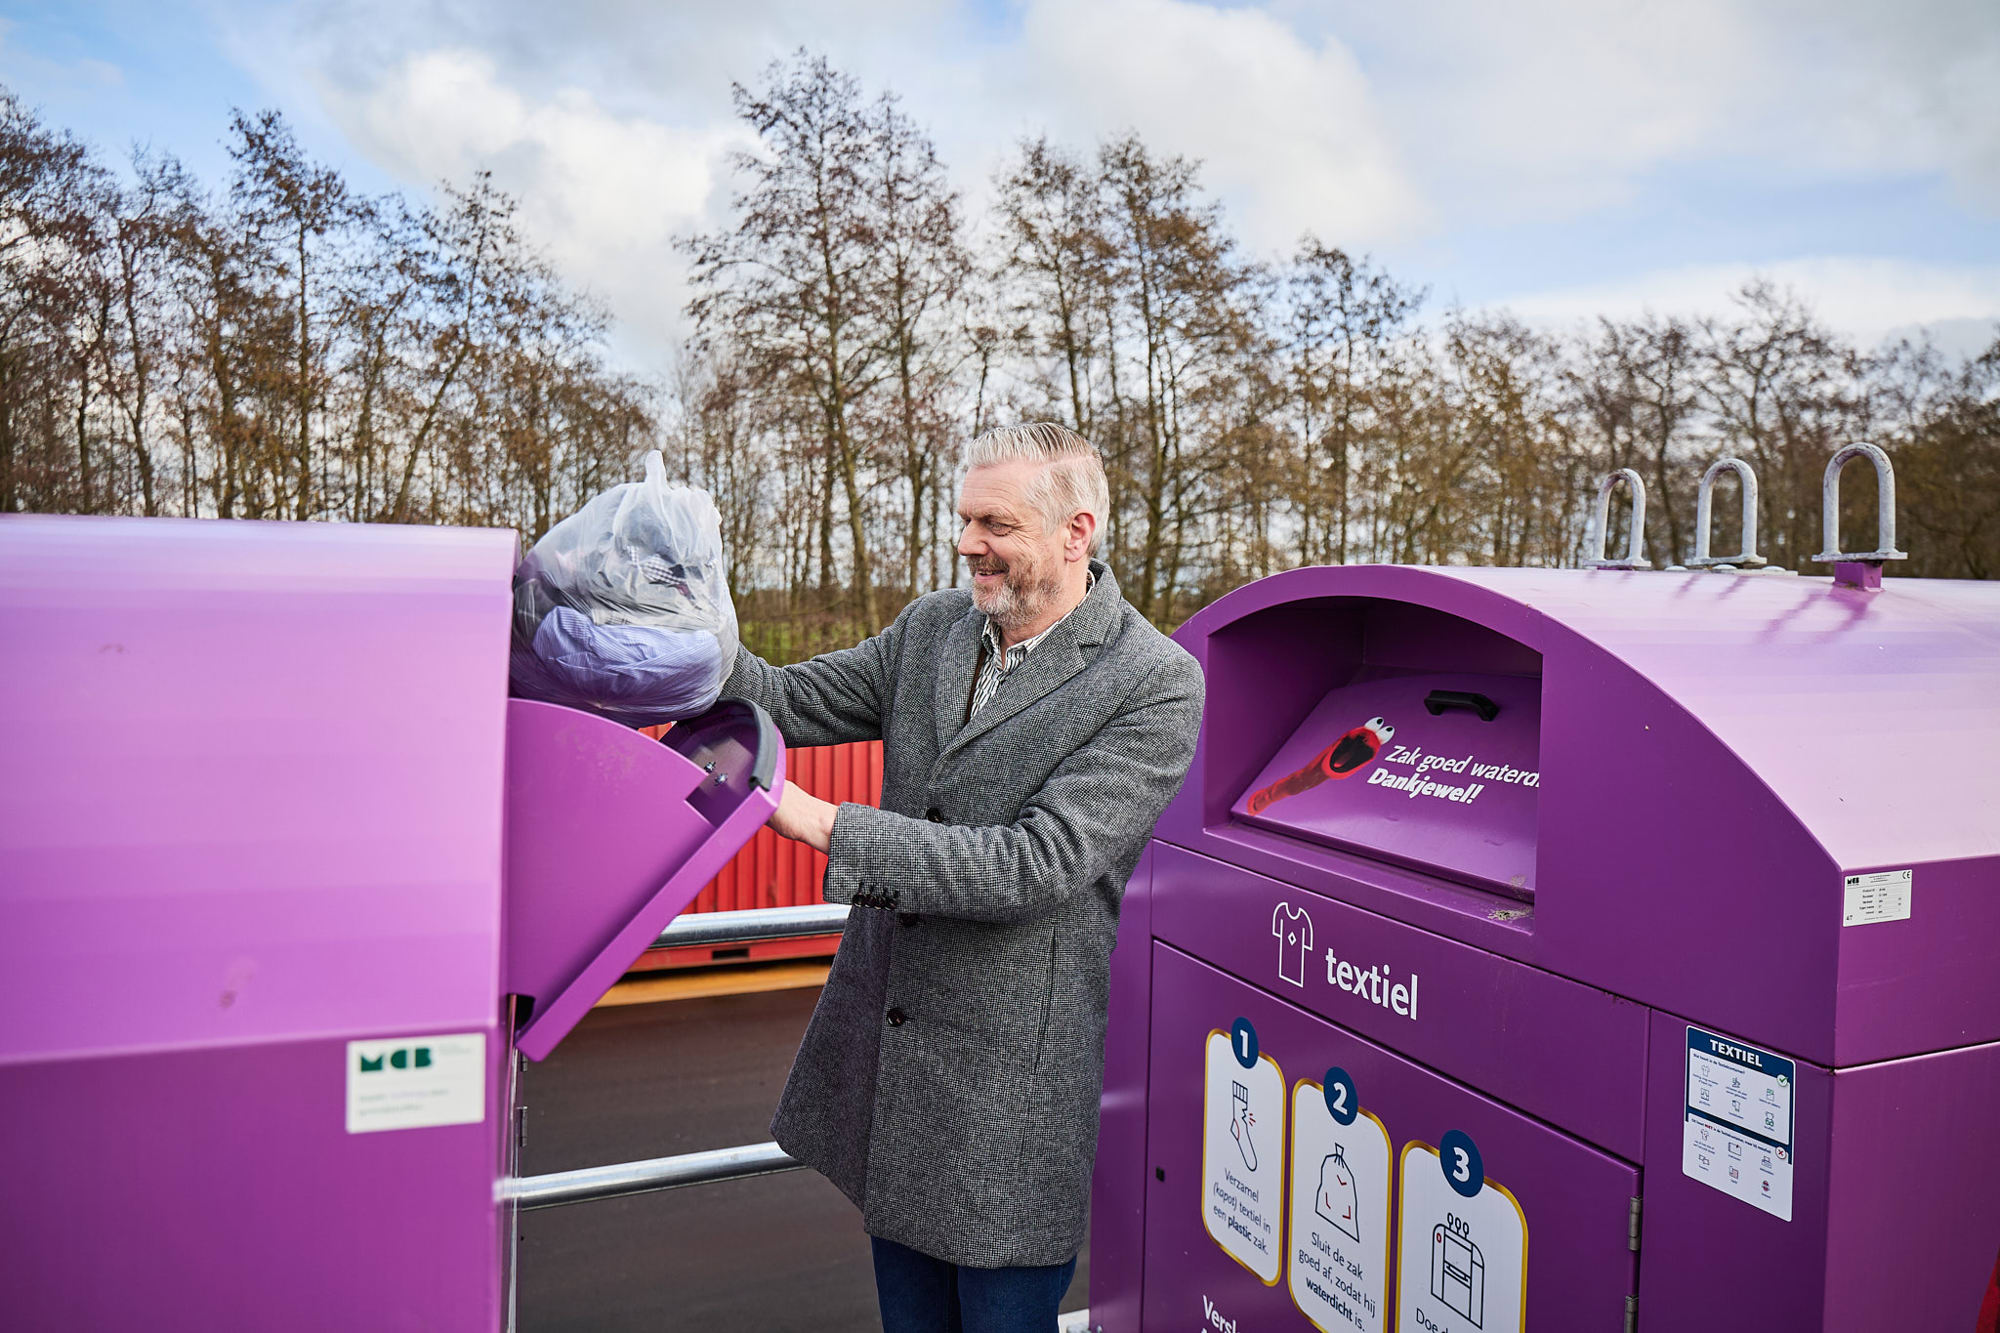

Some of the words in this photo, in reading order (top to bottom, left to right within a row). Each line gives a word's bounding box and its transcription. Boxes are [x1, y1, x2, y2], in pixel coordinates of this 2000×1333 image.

[1384, 745, 1422, 766] Zak
[1416, 755, 1473, 774] goed
[1367, 767, 1485, 805] Dankjewel!
[1325, 947, 1418, 1021] textiel
[1239, 1029, 1249, 1059] 1
[1709, 1039, 1763, 1068] TEXTIEL
[1332, 1082, 1348, 1116] 2
[1452, 1146, 1470, 1183] 3
[1224, 1168, 1259, 1203] Verzamel
[1213, 1205, 1227, 1221] een
[1228, 1215, 1252, 1242] plastic
[1253, 1236, 1269, 1255] zak.
[1239, 1202, 1262, 1227] textiel
[1263, 1218, 1271, 1234] in
[1311, 1231, 1331, 1257] Sluit
[1332, 1248, 1345, 1266] de
[1346, 1260, 1363, 1280] zak
[1298, 1249, 1320, 1272] goed
[1322, 1266, 1333, 1284] af,
[1335, 1276, 1361, 1304] zodat
[1363, 1292, 1376, 1319] hij
[1305, 1276, 1353, 1322] waterdicht
[1354, 1312, 1366, 1332] is.
[1416, 1307, 1438, 1333] Doe
